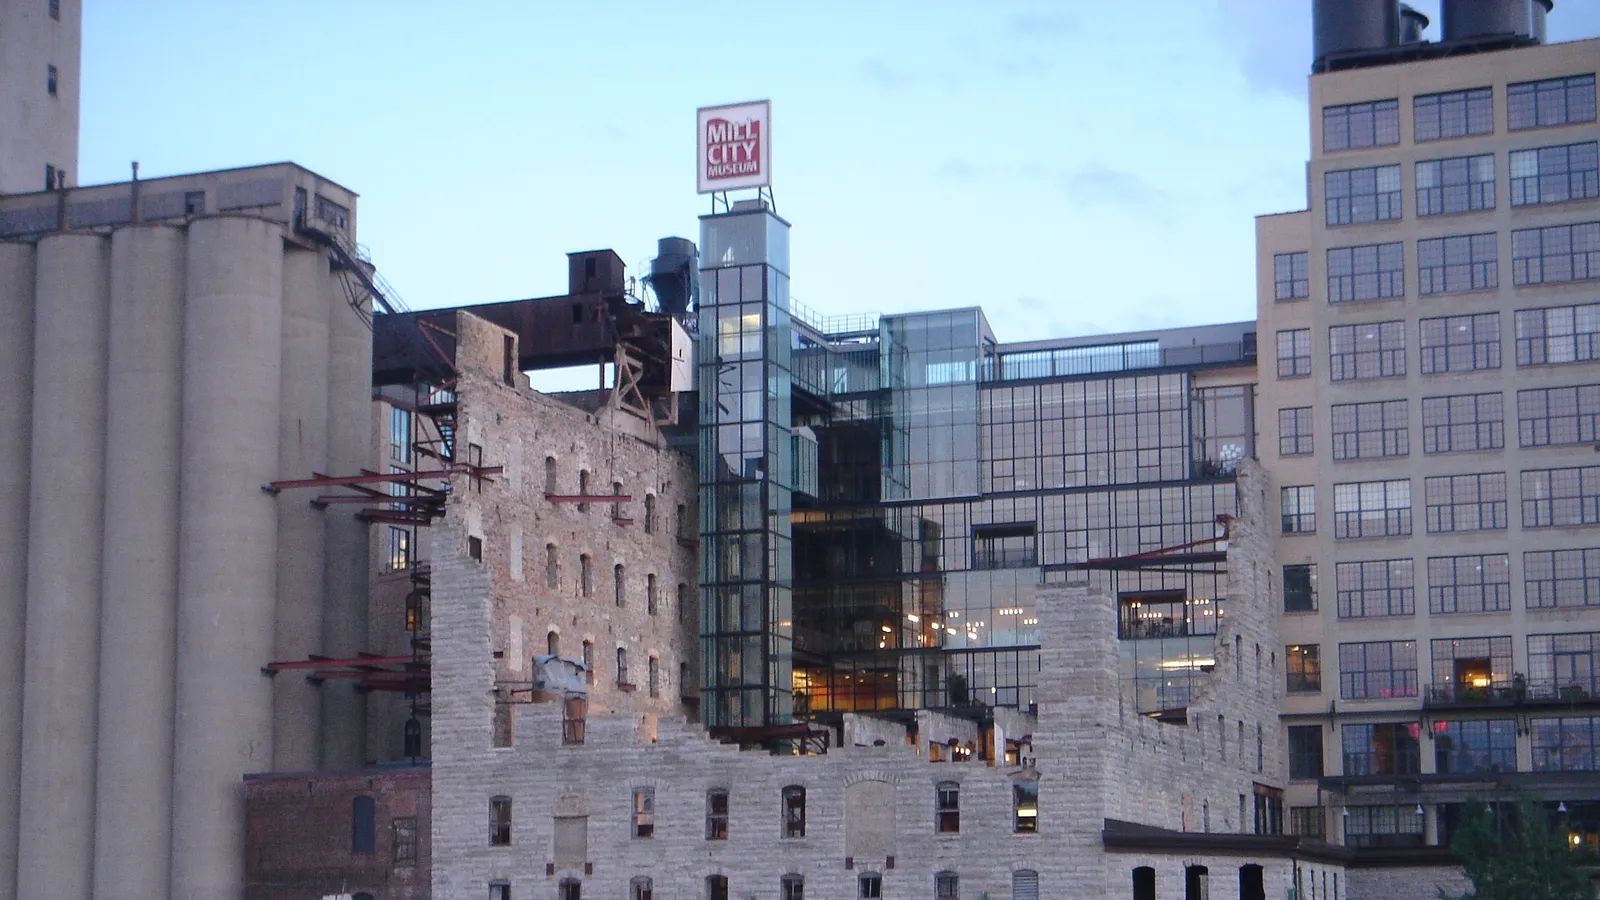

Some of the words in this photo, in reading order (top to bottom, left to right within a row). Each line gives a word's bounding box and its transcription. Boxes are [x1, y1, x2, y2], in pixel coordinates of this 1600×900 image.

[708, 118, 757, 144] MILL
[708, 140, 757, 165] CITY
[708, 161, 757, 177] MUSEUM
